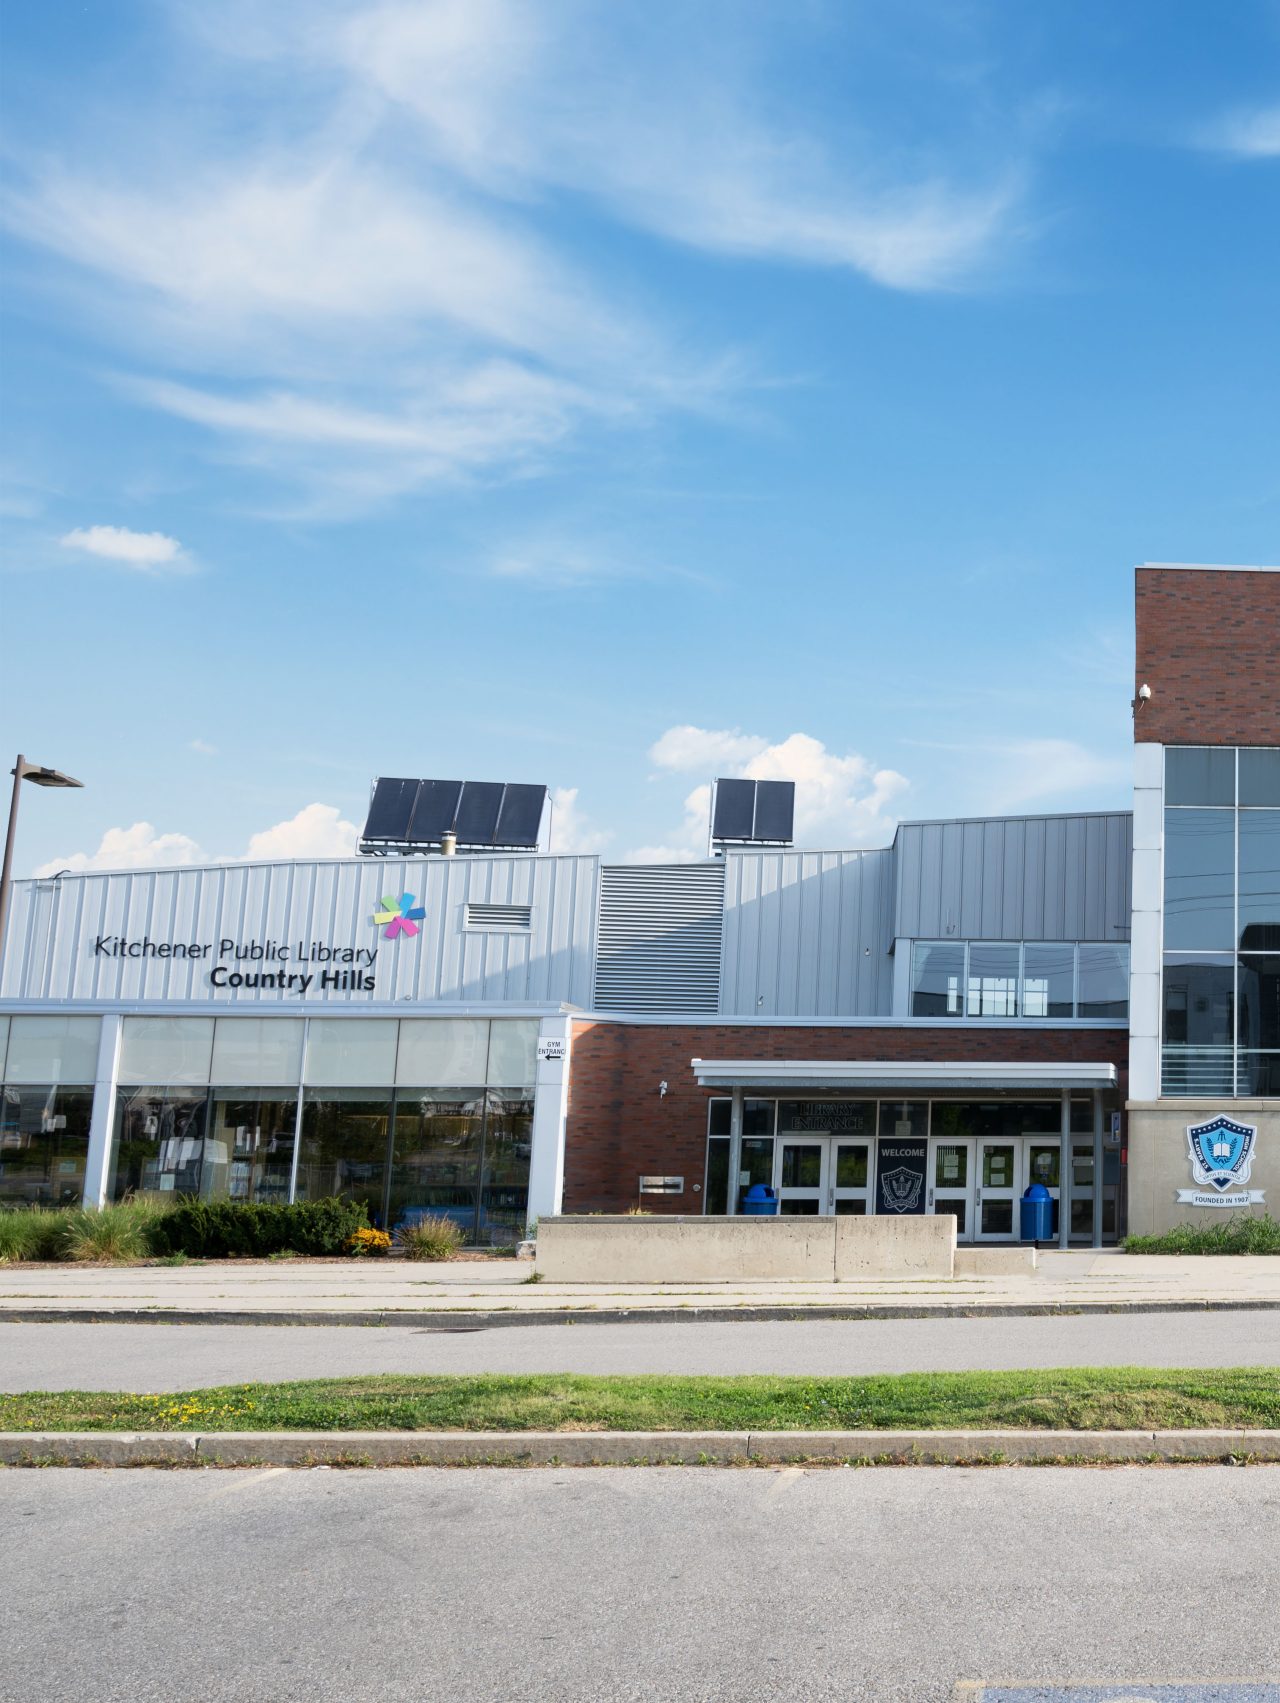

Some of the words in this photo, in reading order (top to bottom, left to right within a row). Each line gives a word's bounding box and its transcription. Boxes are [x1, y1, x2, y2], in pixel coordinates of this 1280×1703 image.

[94, 936, 212, 959] Kitchener
[219, 939, 290, 961] Public
[298, 941, 379, 967] Library
[210, 967, 313, 993] Country
[320, 969, 377, 991] Hills
[800, 1103, 856, 1116] LIBRARY
[791, 1116, 864, 1130] ENTRANCE
[1243, 1135, 1251, 1150] HIGH
[881, 1148, 925, 1157] WELCOME
[1232, 1150, 1247, 1171] SCHOOL
[1195, 1196, 1224, 1204] FOUNDED
[1234, 1196, 1249, 1204] 1907
